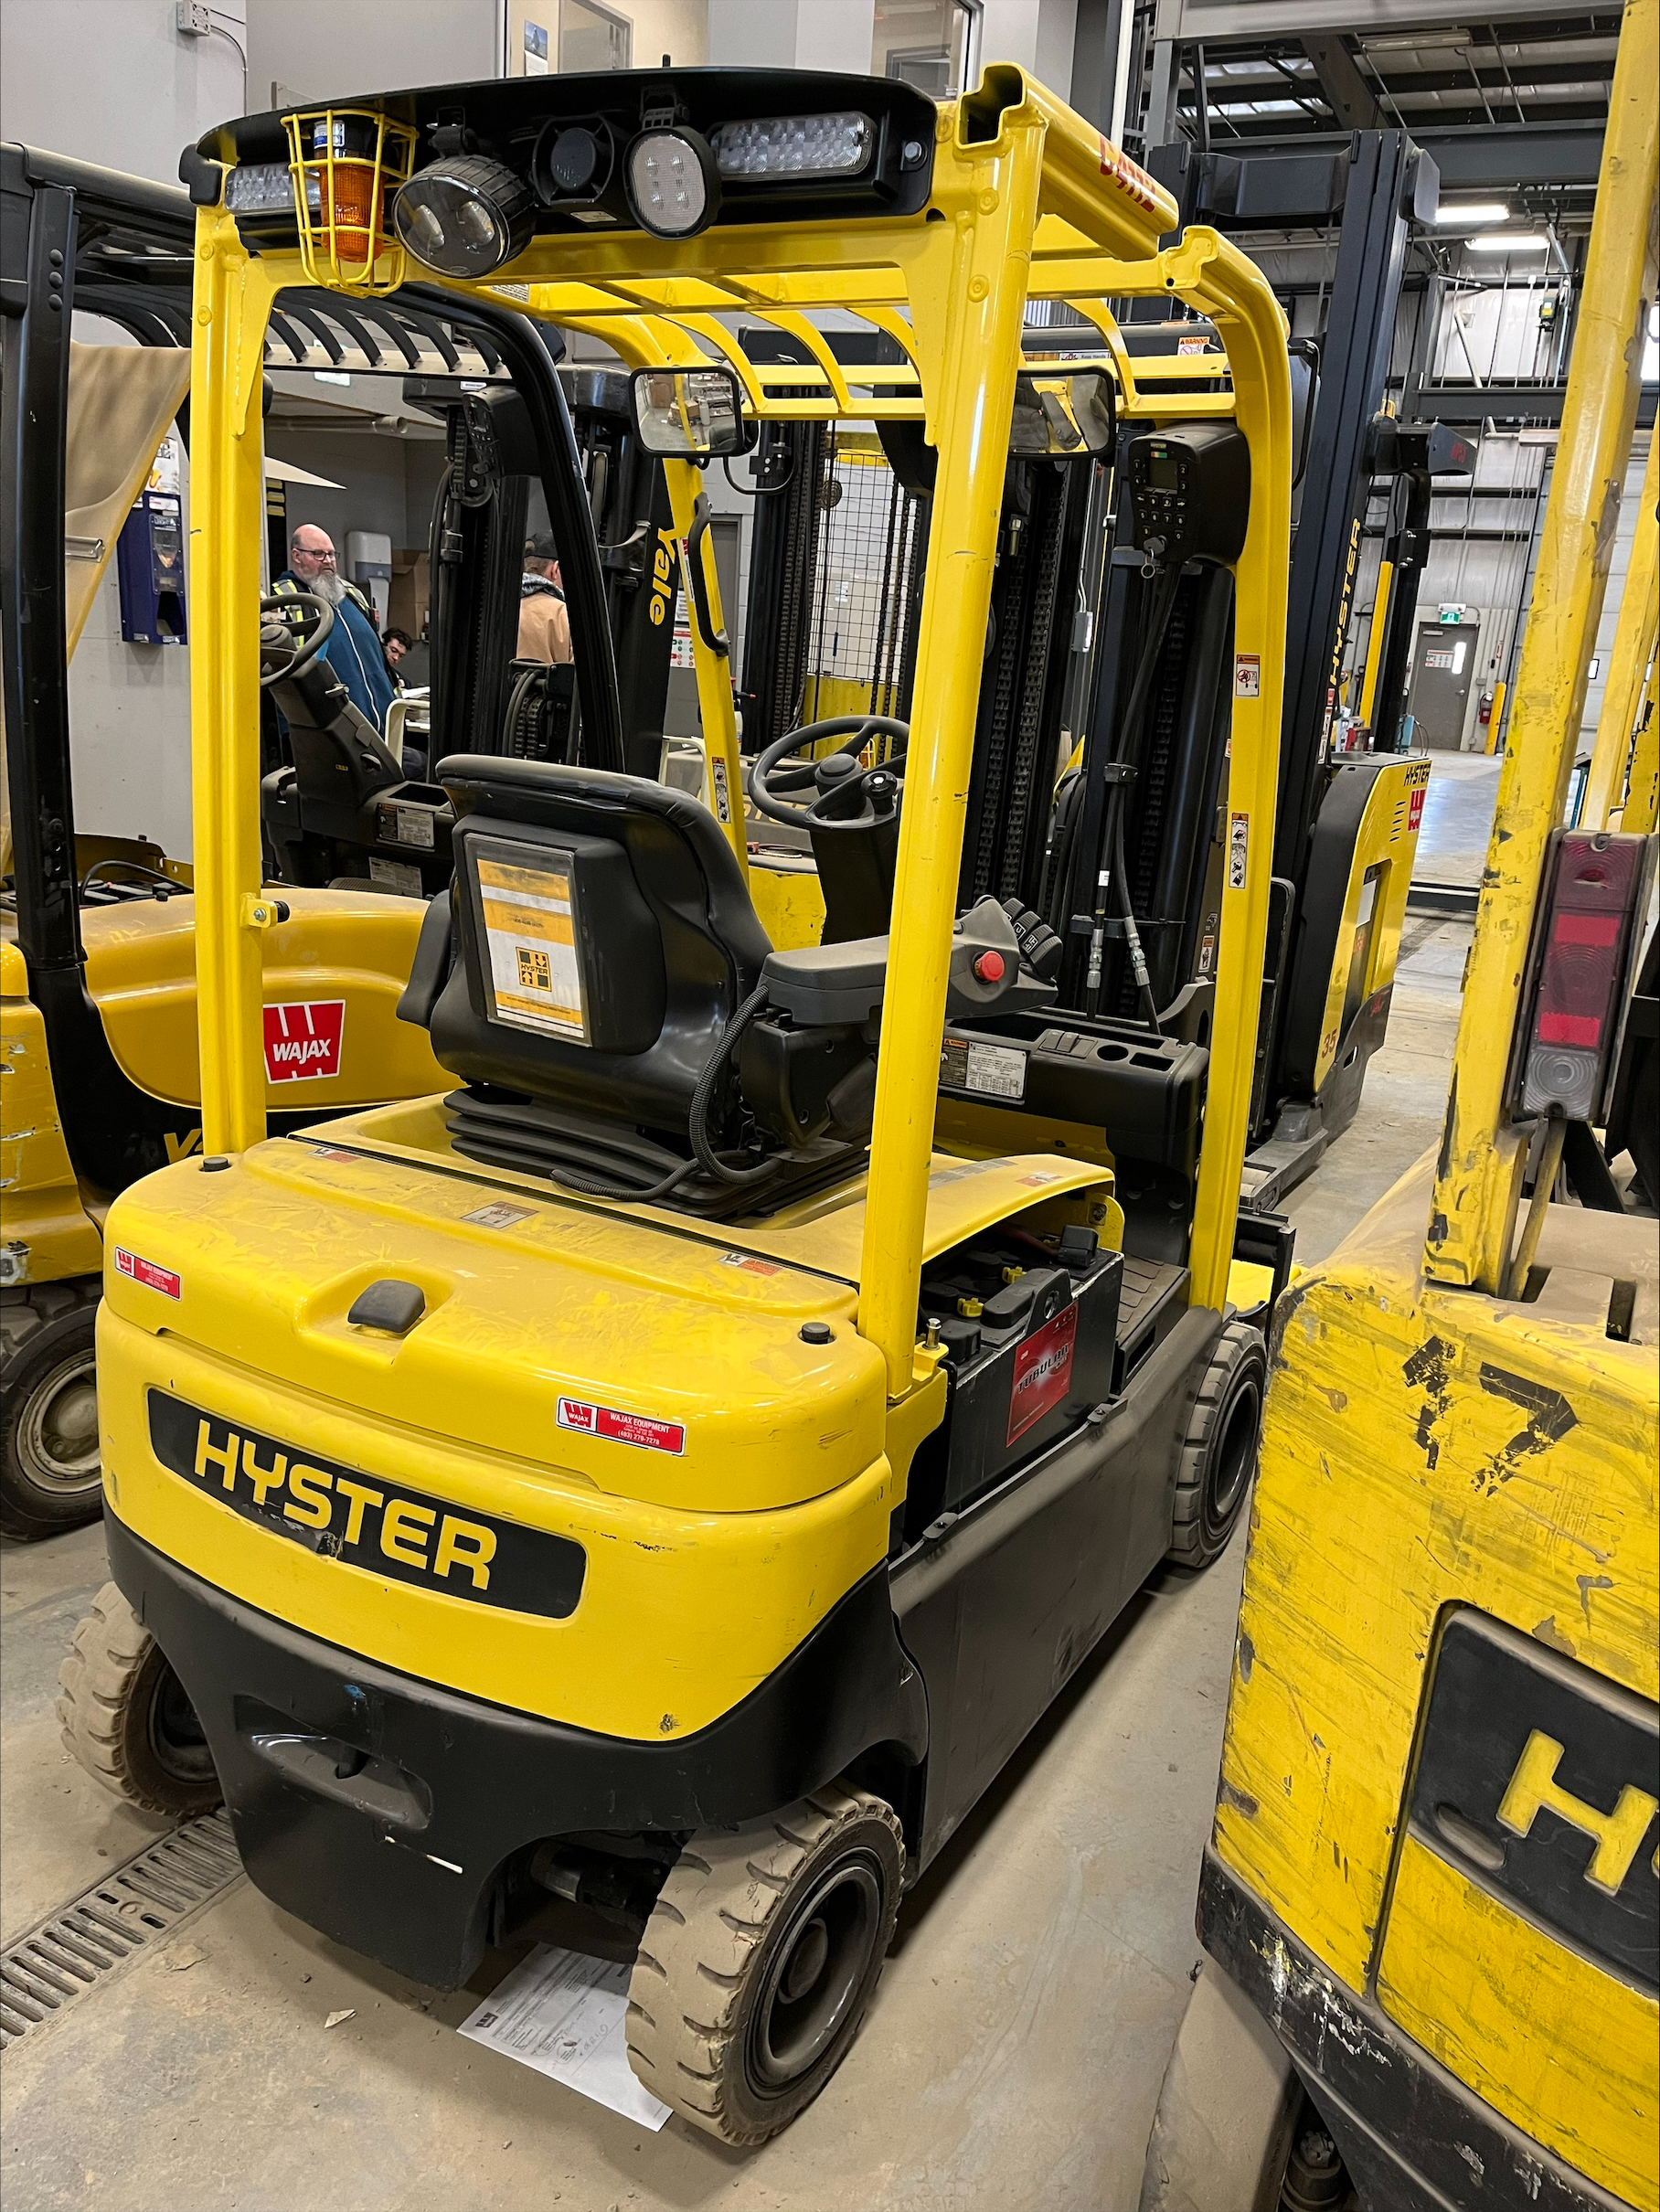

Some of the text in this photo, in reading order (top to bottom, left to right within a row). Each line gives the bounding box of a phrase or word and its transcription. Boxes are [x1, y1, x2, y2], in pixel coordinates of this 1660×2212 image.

[649, 527, 678, 626] Yale
[1328, 517, 1361, 686] HYSTER
[1403, 763, 1431, 786] HYSTER
[520, 963, 548, 975] HYSTER
[272, 1038, 331, 1065] WAJAX
[1321, 1028, 1338, 1058] 35
[1016, 1344, 1069, 1394] TUBULAR
[568, 1412, 589, 1423] WAJAX
[610, 1412, 633, 1425] WAJAX
[633, 1419, 670, 1433] EQUIPMENT
[194, 1419, 497, 1591] HYSTER
[1496, 1728, 1660, 1897] H
